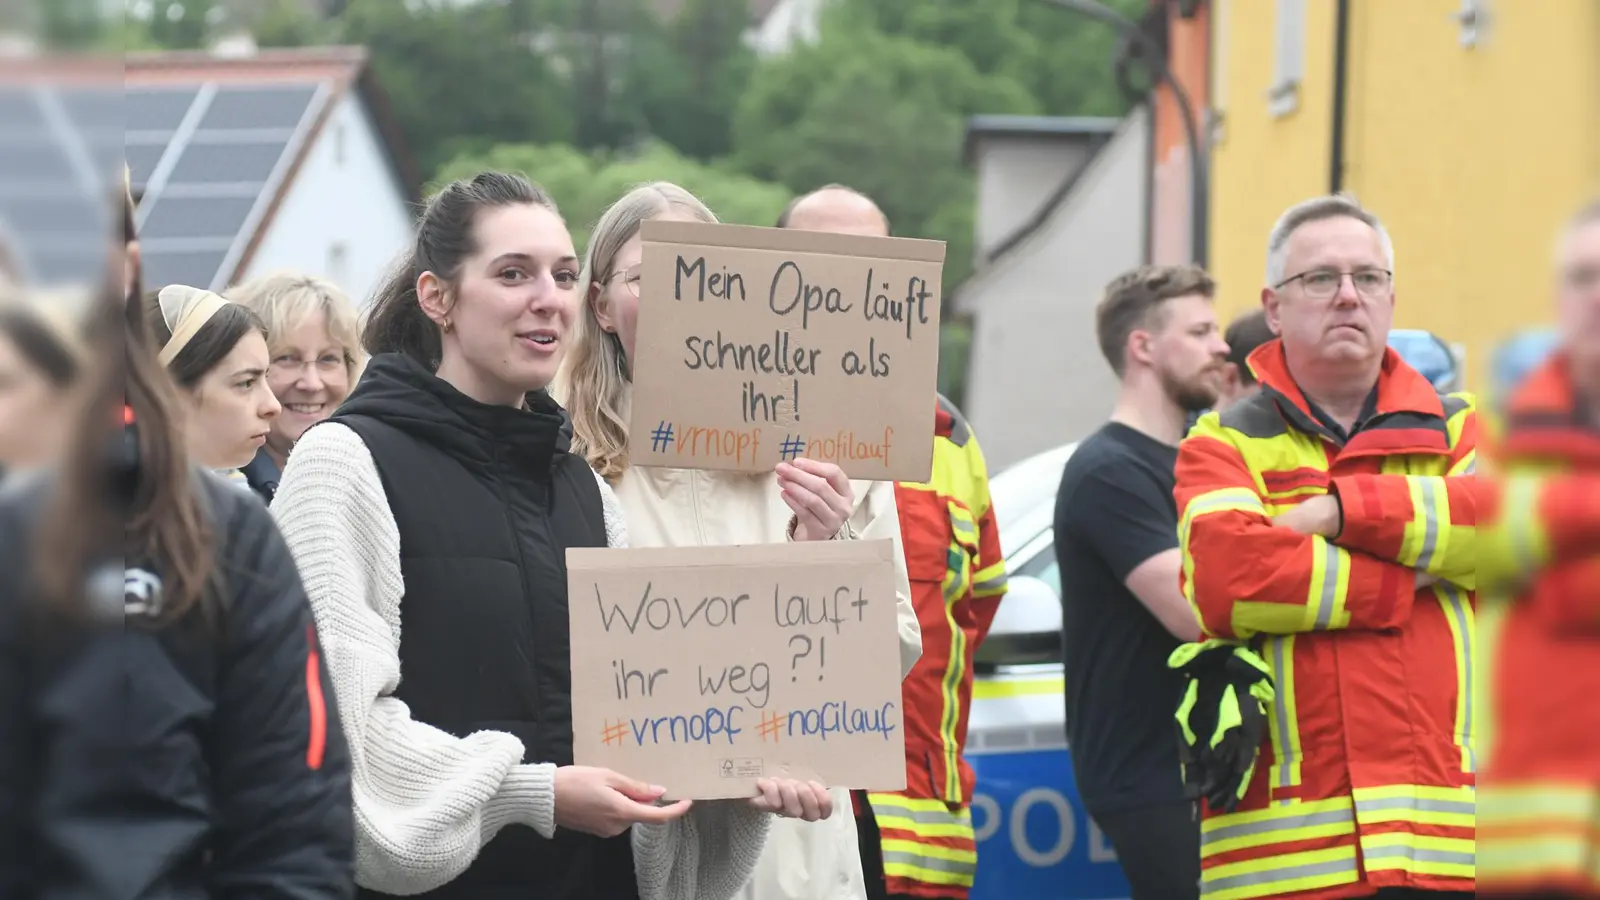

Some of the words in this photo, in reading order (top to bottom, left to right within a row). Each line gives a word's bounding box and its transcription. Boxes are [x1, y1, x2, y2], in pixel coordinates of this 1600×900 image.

[674, 255, 746, 301] Mein
[769, 260, 853, 329] Opa
[863, 267, 933, 340] läuft
[684, 330, 821, 376] schneller
[841, 337, 891, 378] als
[742, 379, 800, 423] ihr!
[651, 420, 761, 466] #vrnopf
[779, 426, 894, 468] #nofilauf
[594, 581, 750, 635] Wovor
[773, 585, 869, 635] lauft
[612, 659, 669, 700] ihr
[698, 662, 770, 709] weg
[601, 706, 744, 747] #vrnopf
[754, 701, 896, 744] #nofilauf
